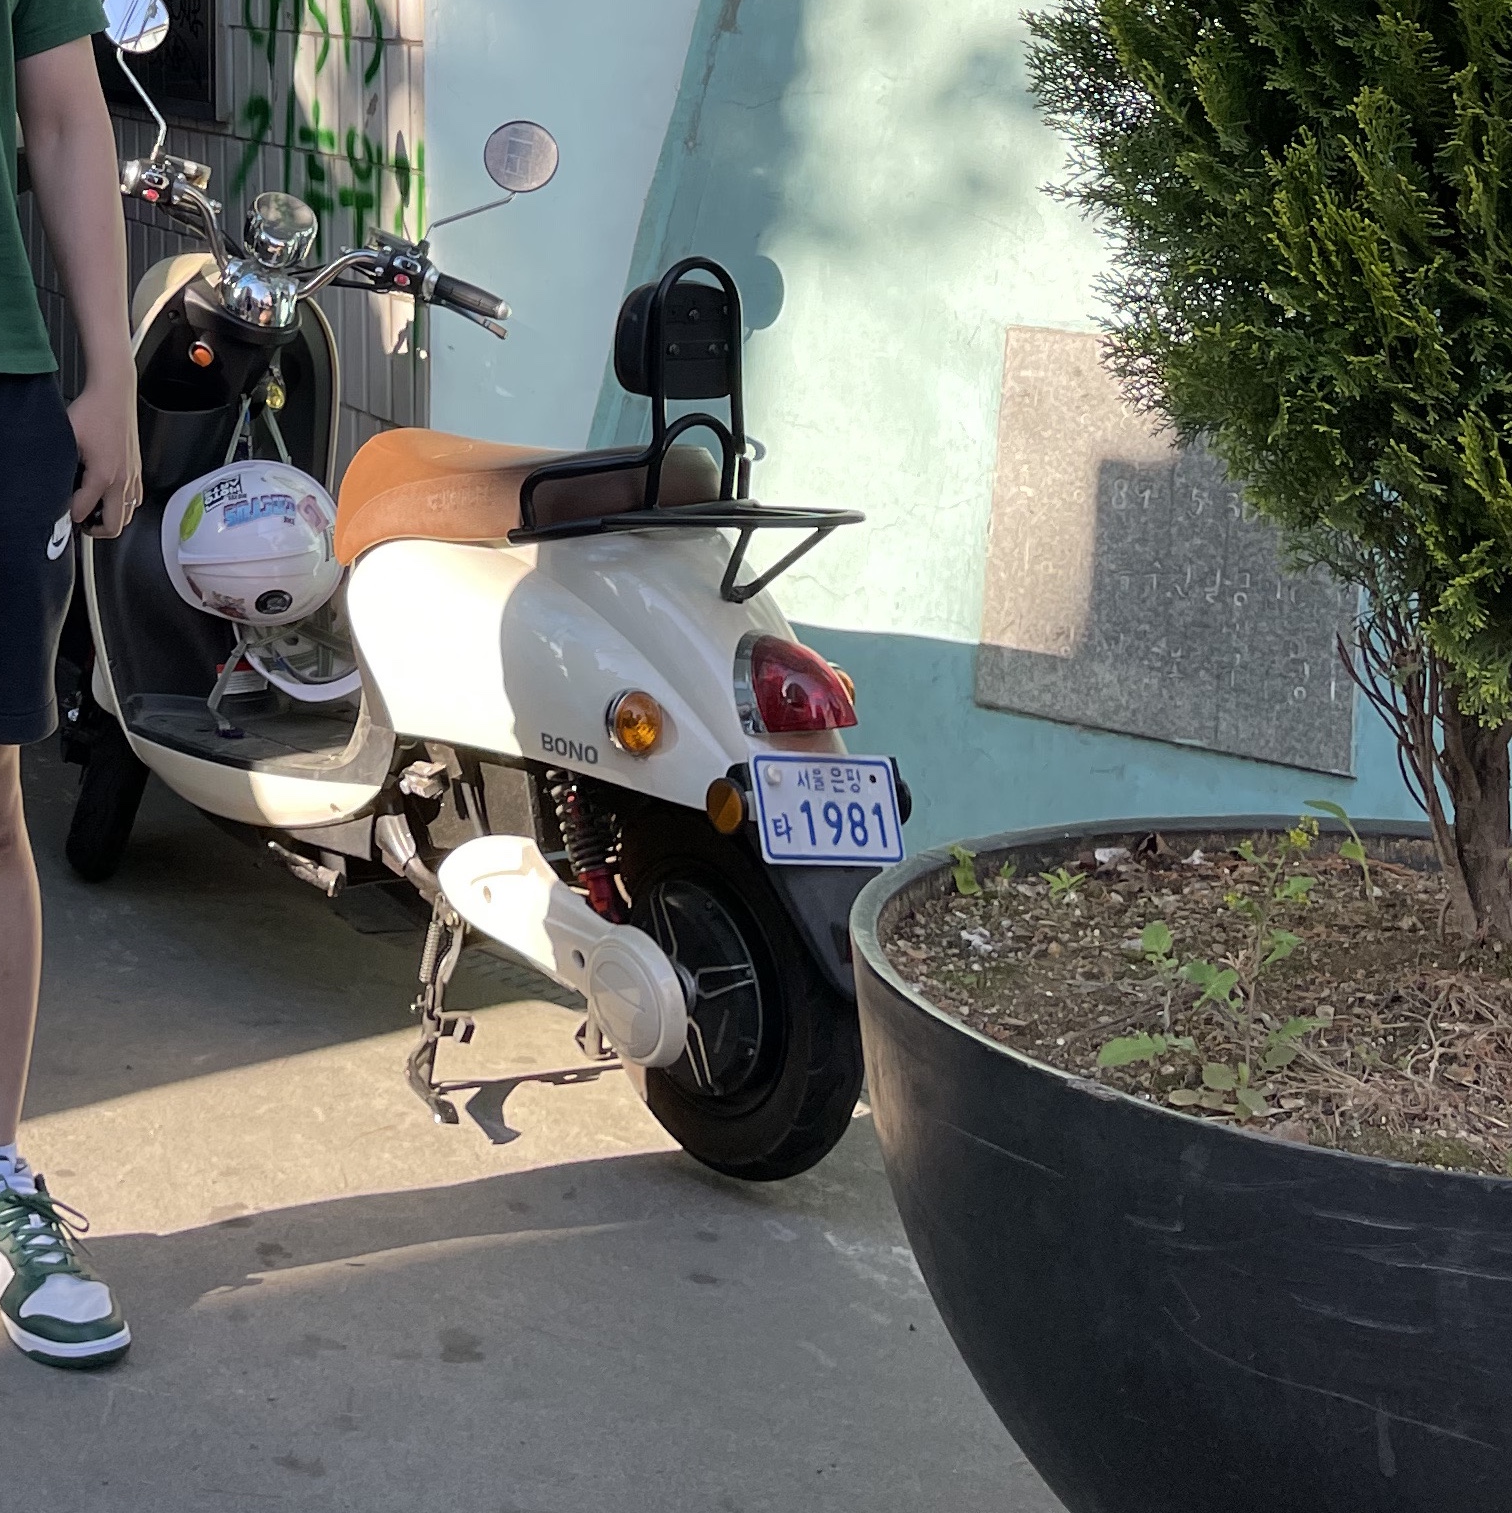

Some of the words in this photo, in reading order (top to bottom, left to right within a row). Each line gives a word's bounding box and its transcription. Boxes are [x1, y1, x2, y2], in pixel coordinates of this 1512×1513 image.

[541, 732, 598, 764] BONO
[798, 767, 825, 792] 서울
[831, 767, 861, 793] 은평
[772, 812, 792, 844] 타
[800, 799, 888, 849] 1981
